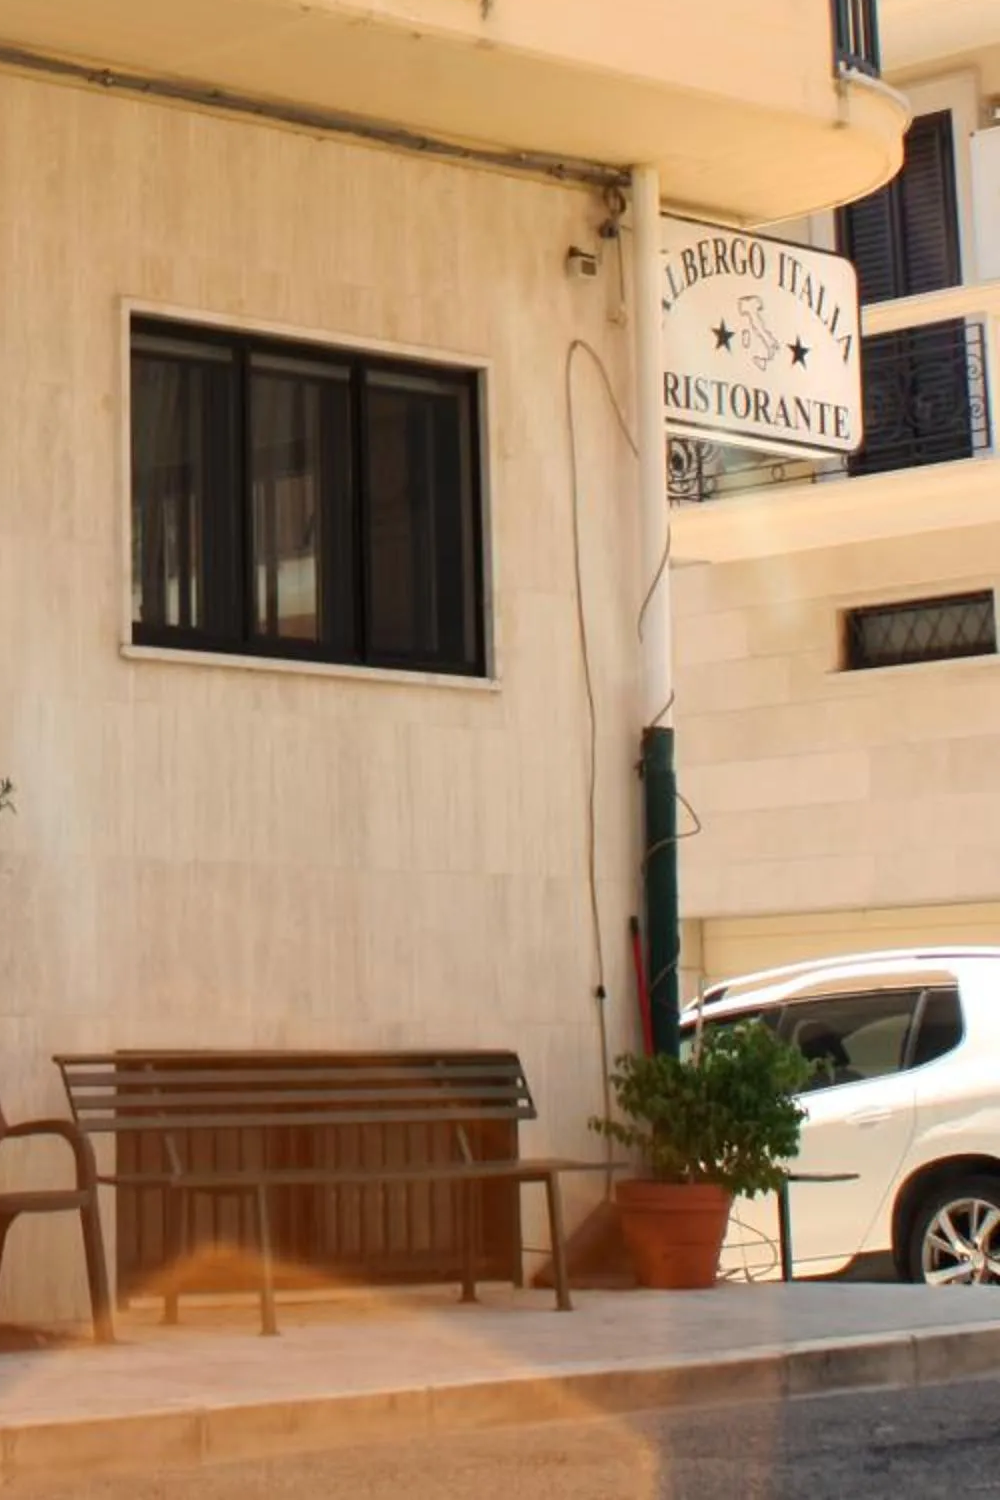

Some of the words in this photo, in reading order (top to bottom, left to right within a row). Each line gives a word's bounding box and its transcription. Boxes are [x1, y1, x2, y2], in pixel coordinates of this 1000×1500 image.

[661, 238, 765, 311] LBERGO
[777, 252, 853, 363] ITALIA
[663, 371, 851, 441] RISTORANTE
